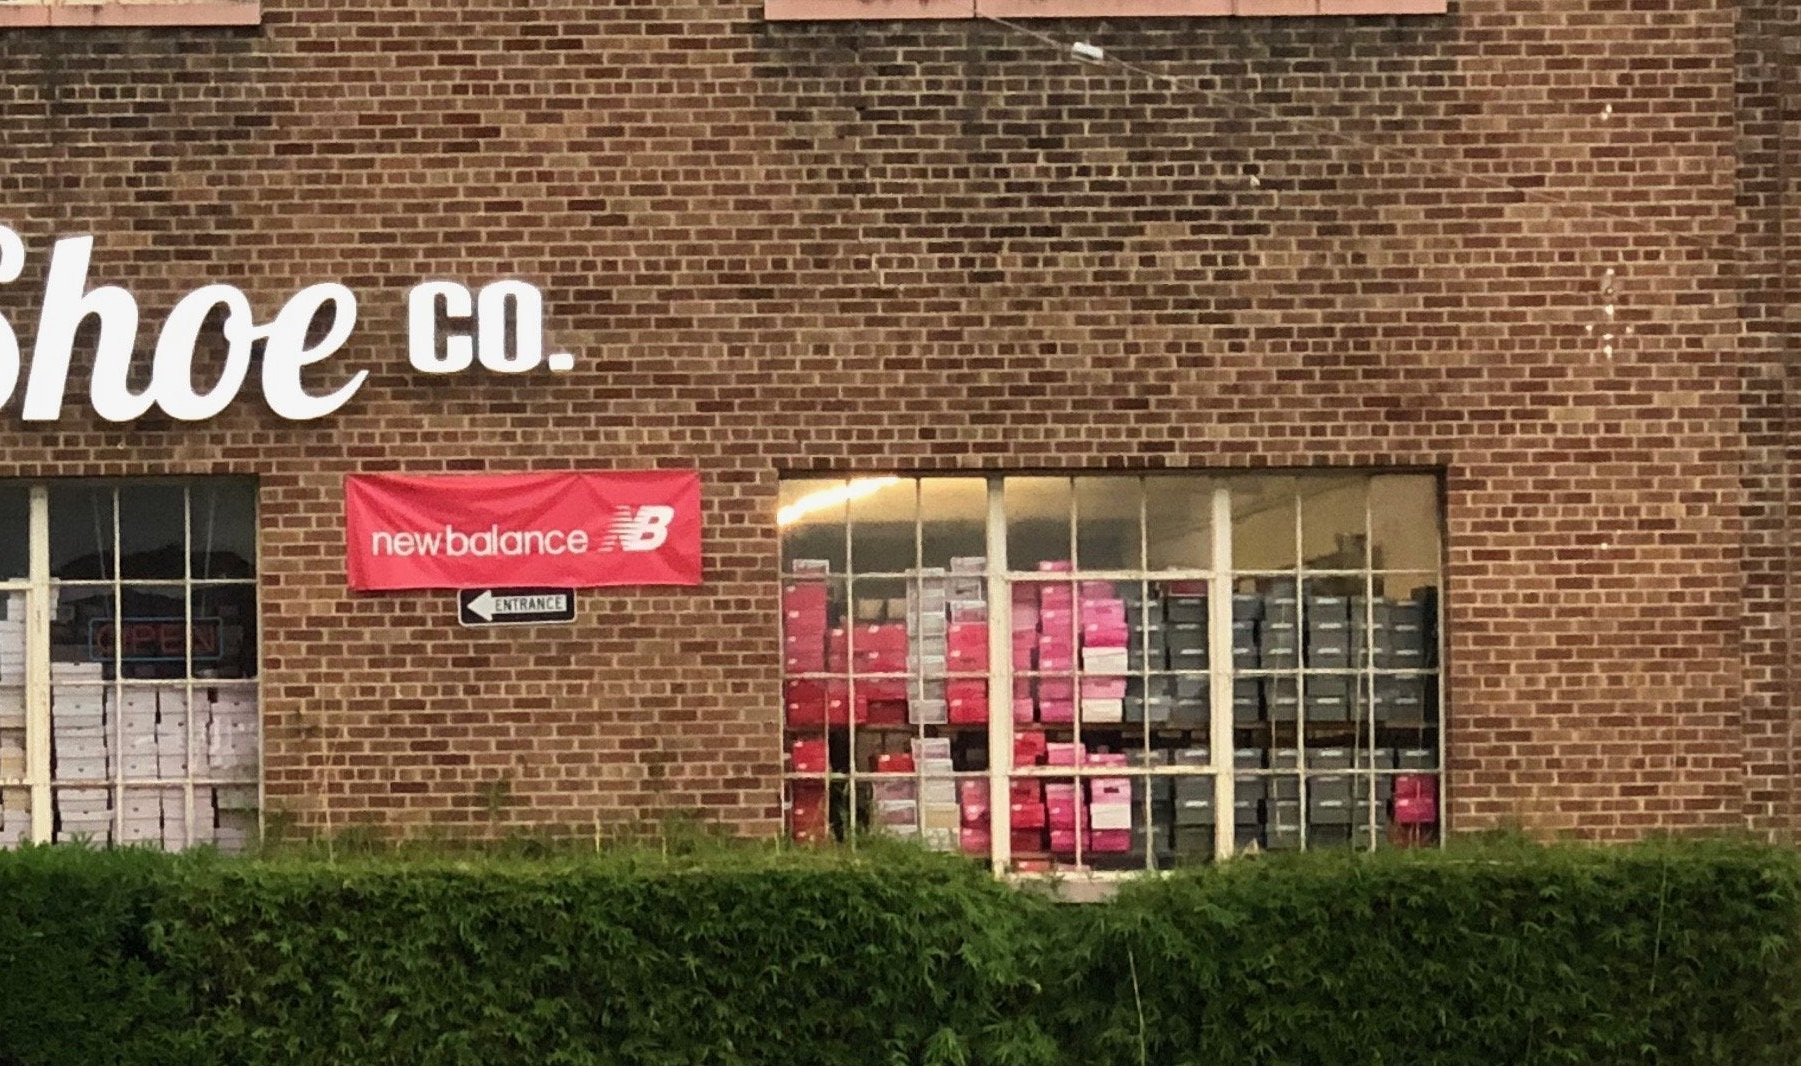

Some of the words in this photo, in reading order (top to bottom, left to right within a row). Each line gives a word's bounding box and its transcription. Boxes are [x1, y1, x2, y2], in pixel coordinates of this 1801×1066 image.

[406, 278, 576, 374] CO.
[494, 594, 565, 613] ENTRANCE
[97, 622, 217, 656] OPEN
